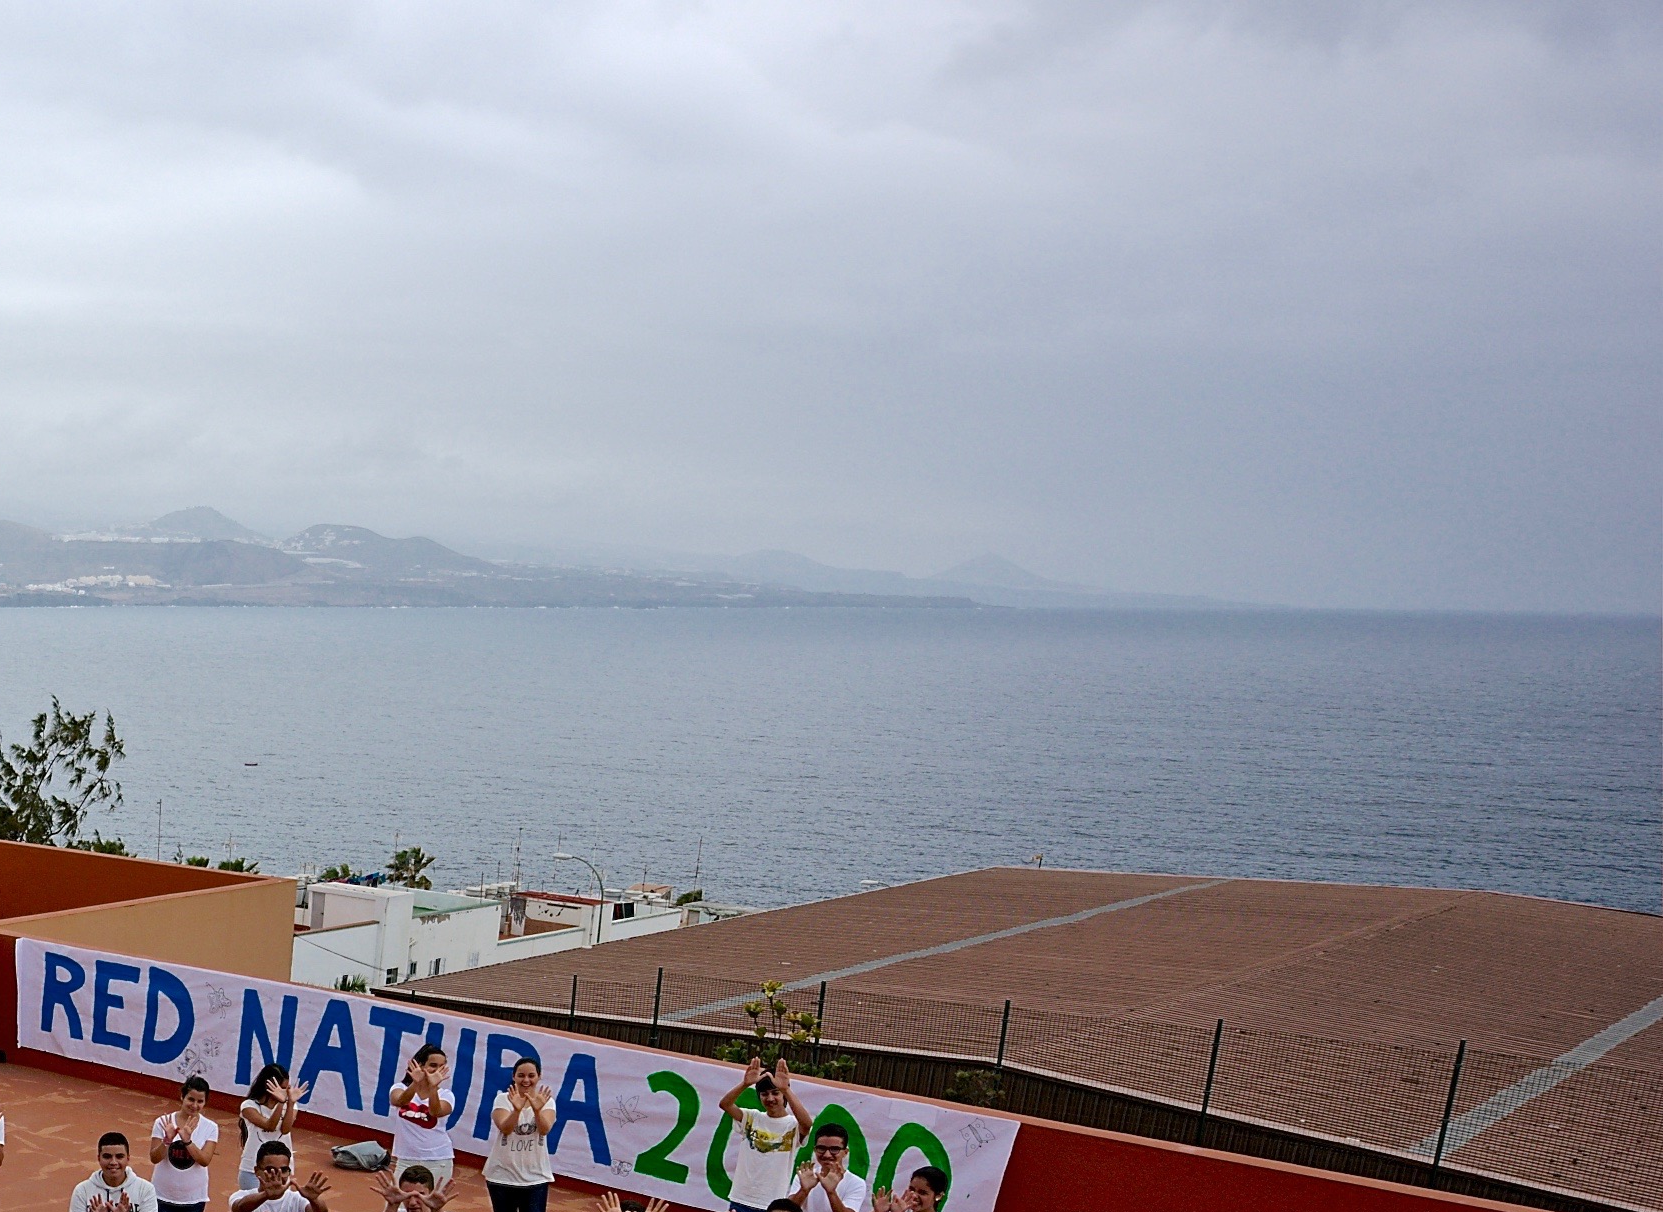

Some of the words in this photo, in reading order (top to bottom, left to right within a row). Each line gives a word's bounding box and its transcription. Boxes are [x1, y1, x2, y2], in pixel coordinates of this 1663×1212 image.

[40, 951, 195, 1064] RED
[234, 988, 612, 1167] NATURA
[510, 1139, 534, 1152] LOVE
